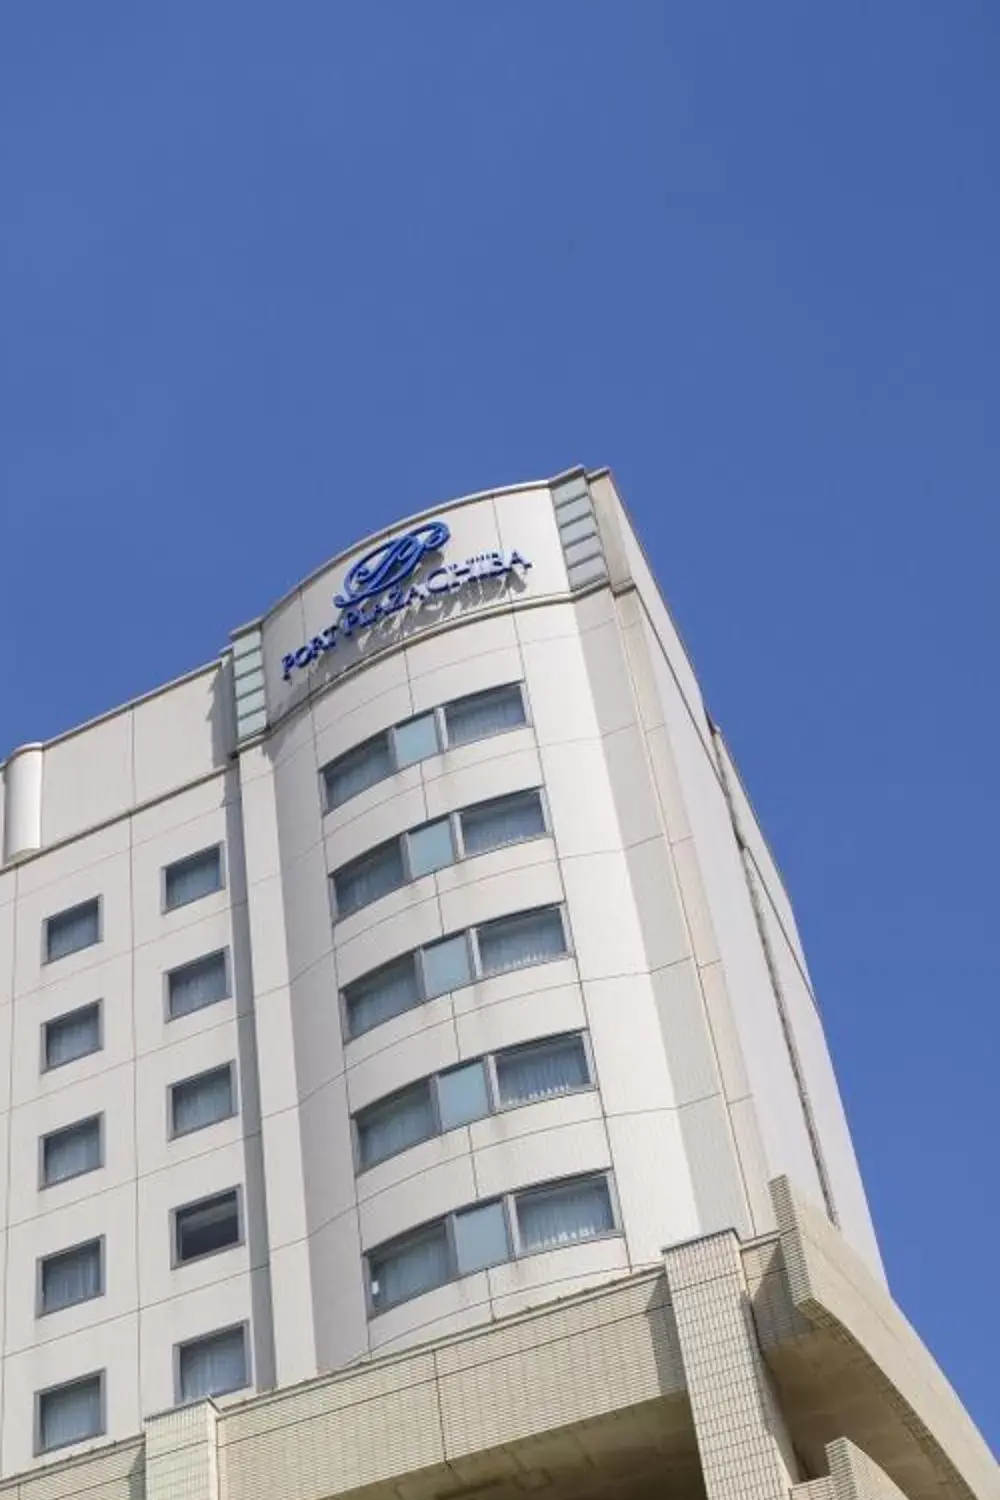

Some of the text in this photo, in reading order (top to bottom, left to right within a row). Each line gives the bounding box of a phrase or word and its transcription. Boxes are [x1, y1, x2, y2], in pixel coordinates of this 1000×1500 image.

[281, 549, 533, 681] PORT PLAZA CHIBA
